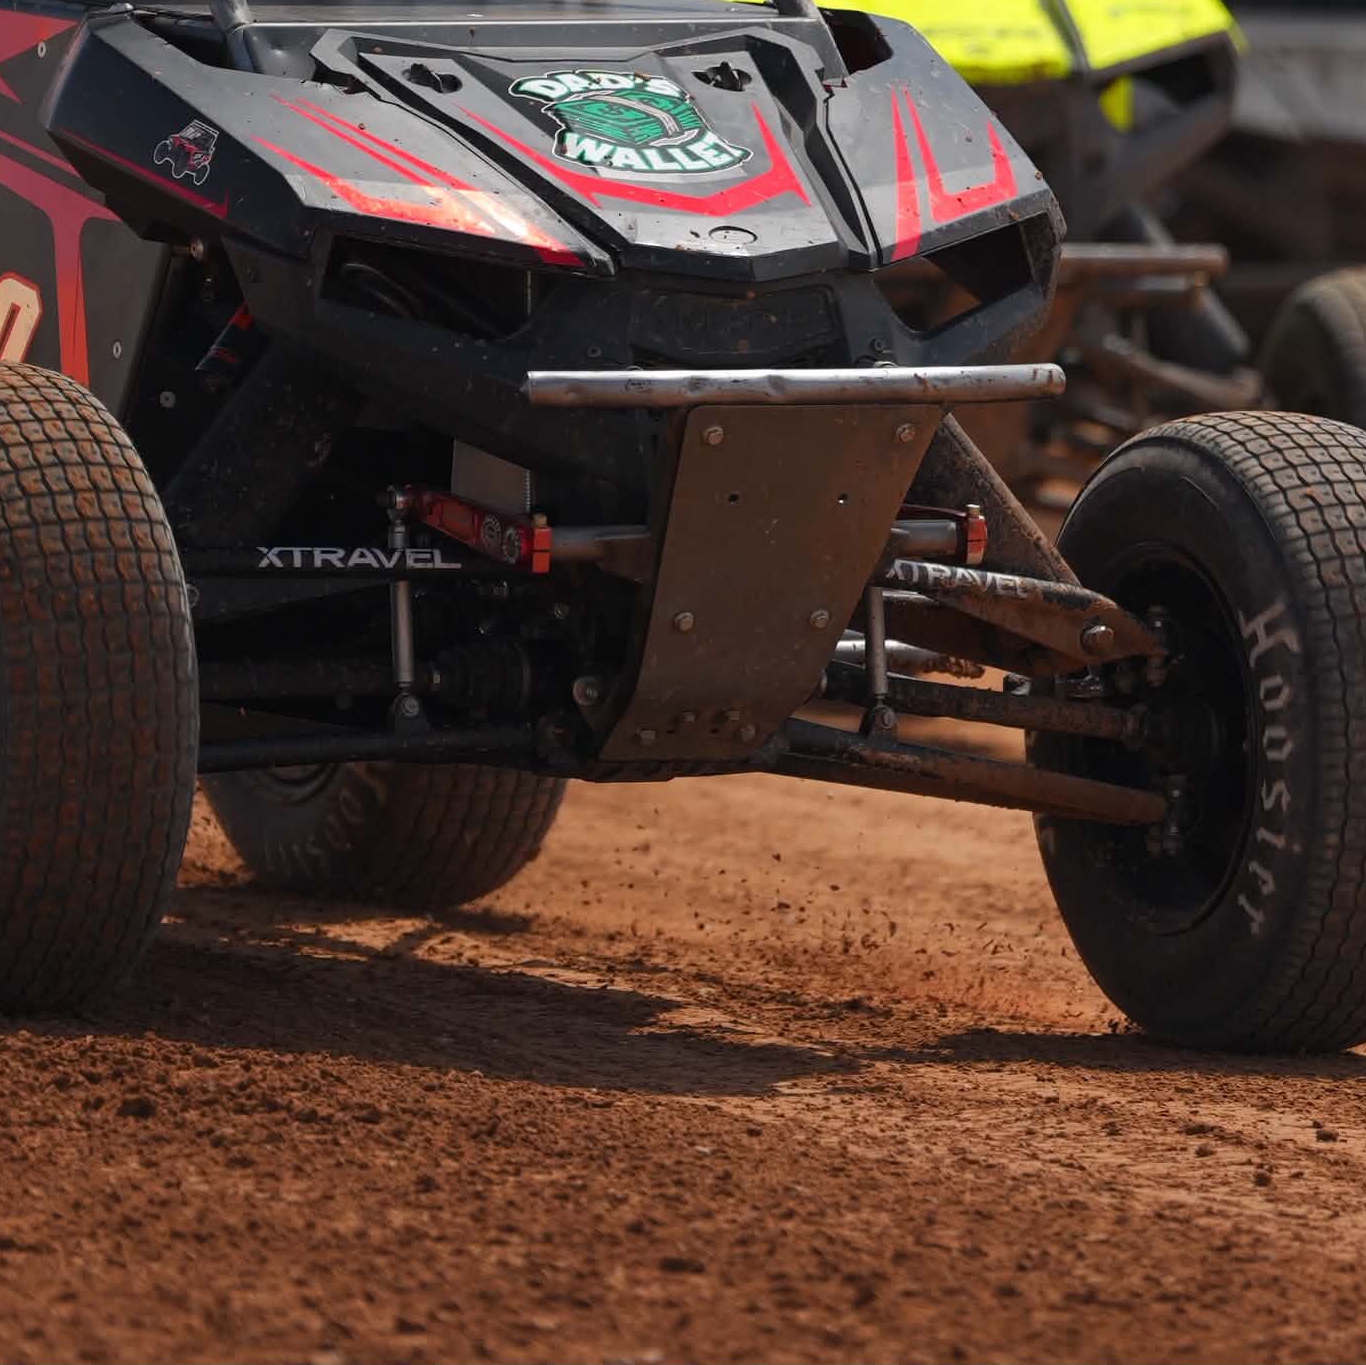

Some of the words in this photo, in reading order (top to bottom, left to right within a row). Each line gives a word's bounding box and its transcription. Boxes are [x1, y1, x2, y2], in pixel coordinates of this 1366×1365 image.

[517, 72, 685, 99] DAD'S
[563, 129, 744, 171] WALLET
[256, 546, 462, 570] XTRAVEL
